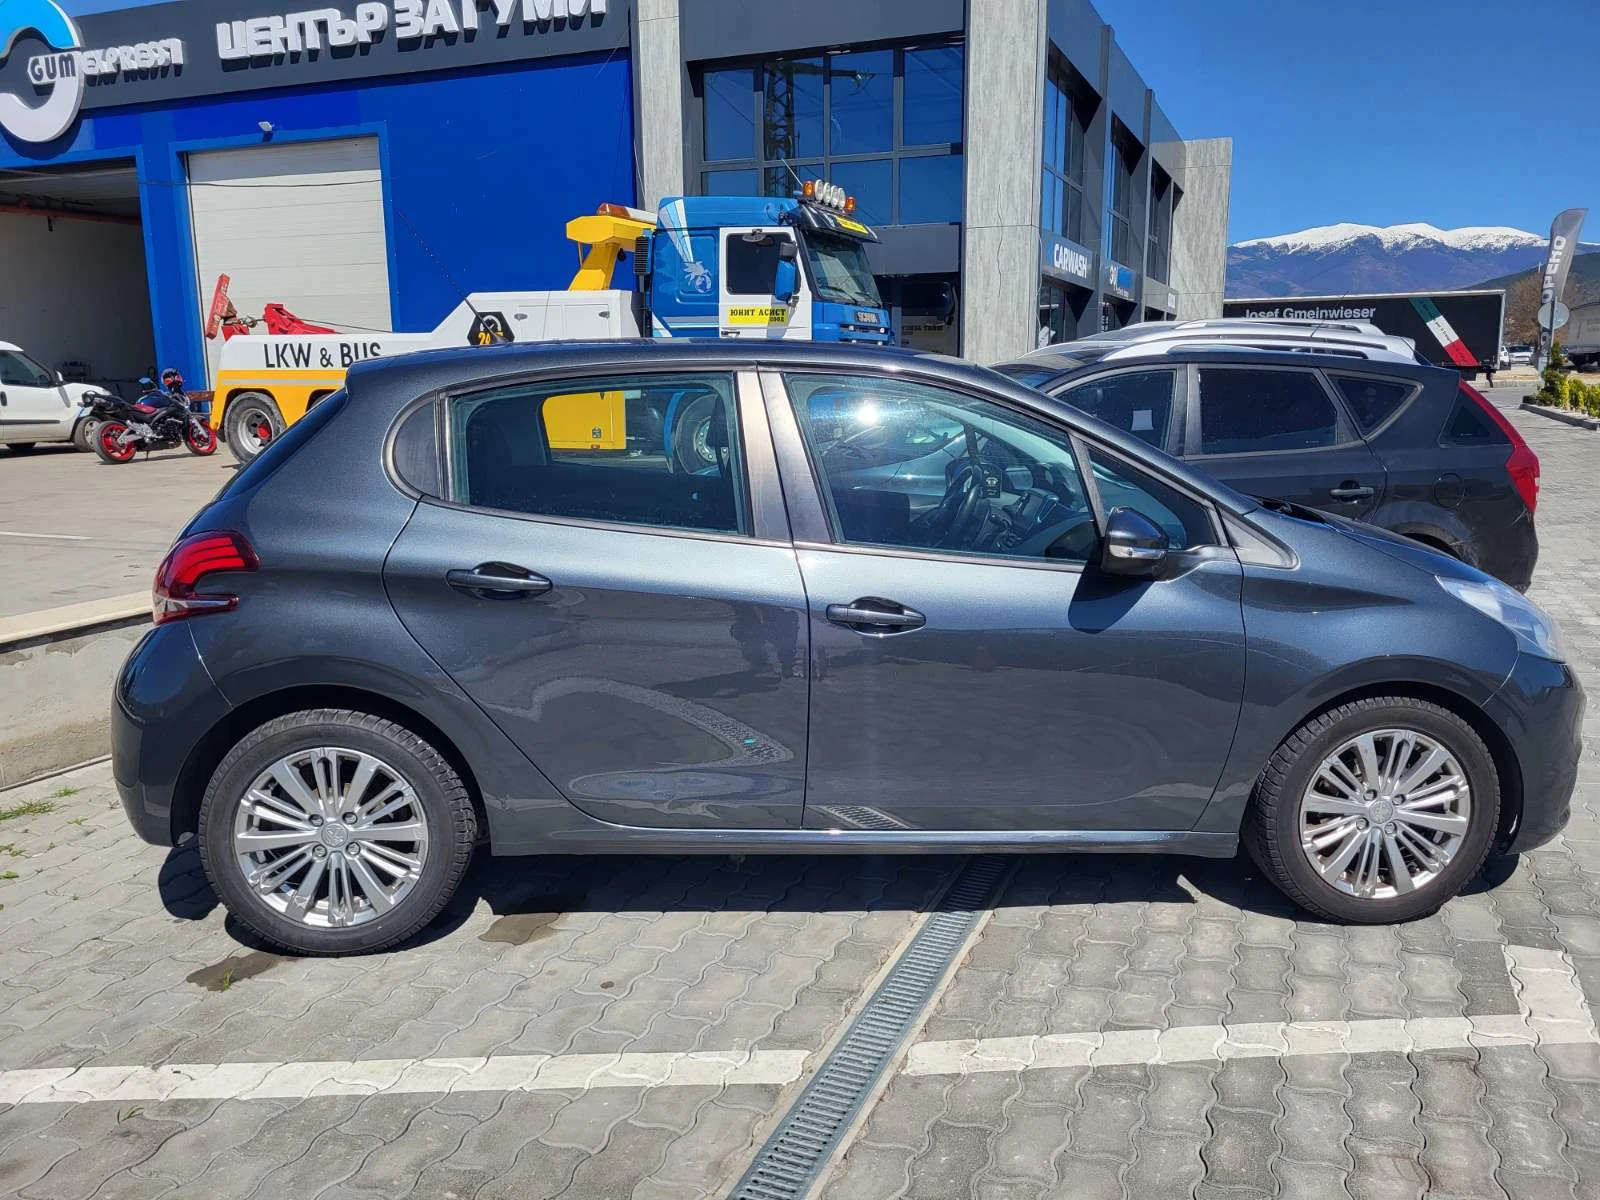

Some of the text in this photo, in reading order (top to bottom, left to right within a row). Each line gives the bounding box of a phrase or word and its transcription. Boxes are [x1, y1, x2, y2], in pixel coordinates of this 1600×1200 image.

[216, 2, 388, 59] ЦЕНТЪР
[395, 0, 459, 38] ЗА
[29, 53, 76, 78] GUM
[1053, 243, 1088, 279] CARWASH
[730, 308, 787, 317] ЮНИТ АСИСТ
[1242, 306, 1377, 320] Josef Gmeinwieser
[264, 342, 382, 369] LKW & BUS
